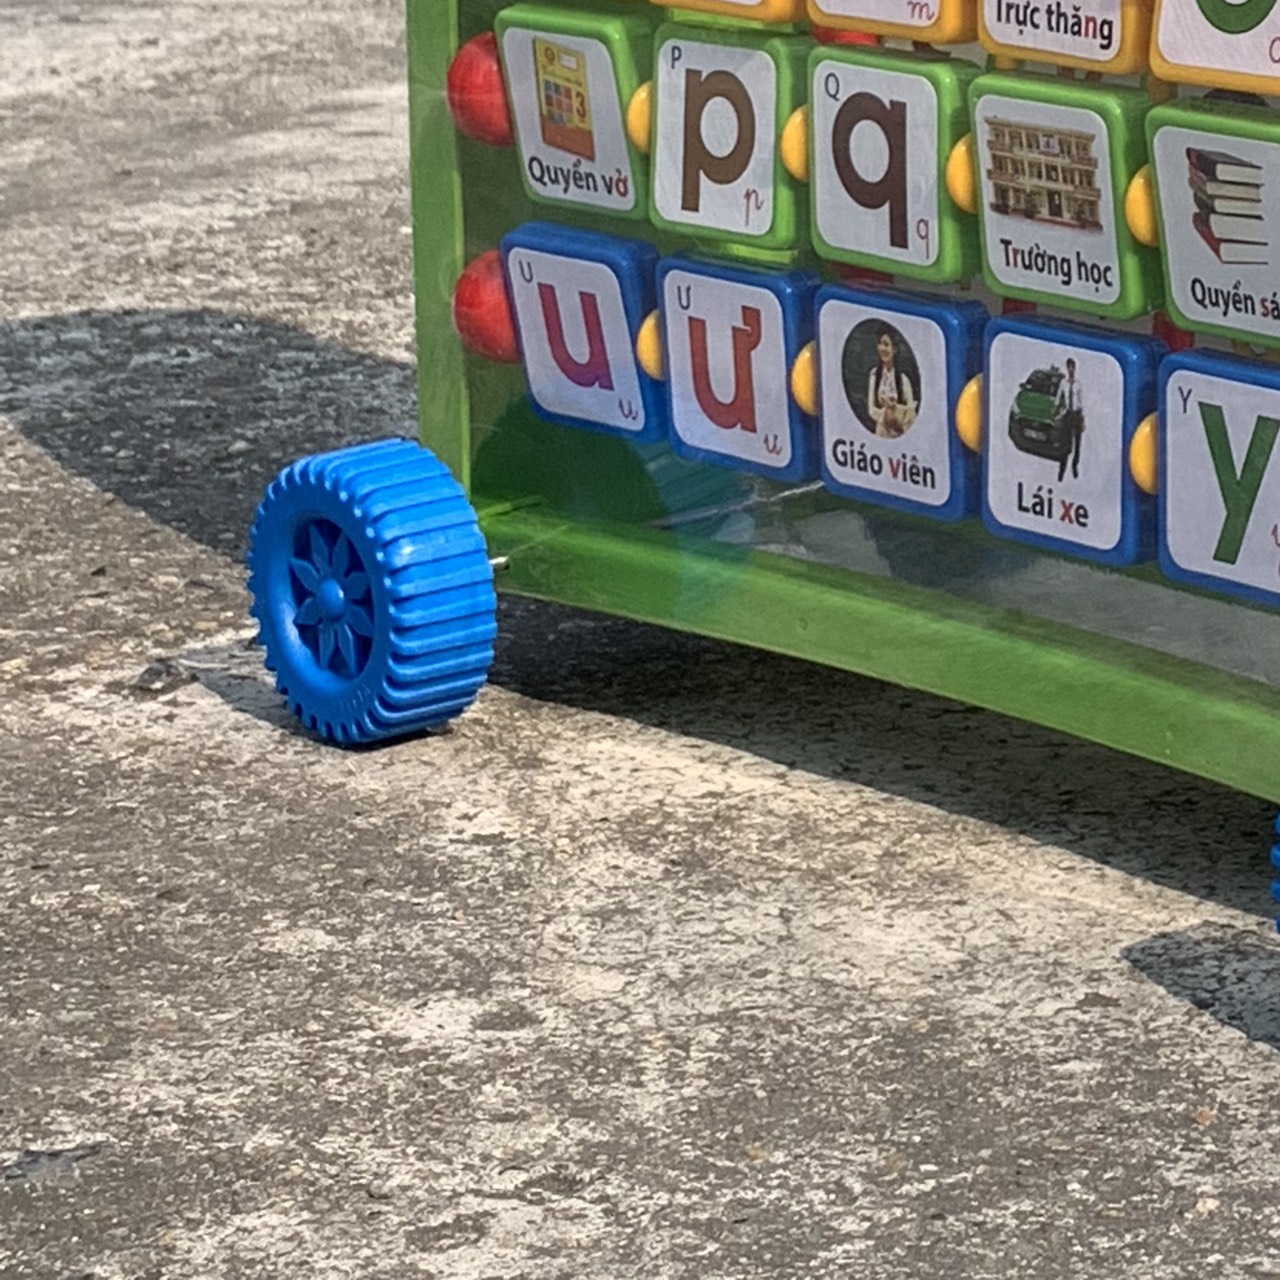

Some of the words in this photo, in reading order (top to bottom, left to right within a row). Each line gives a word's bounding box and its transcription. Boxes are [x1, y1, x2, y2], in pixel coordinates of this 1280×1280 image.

[1046, 1, 1114, 50] thăng
[671, 45, 682, 70] P
[824, 72, 841, 103] Q
[680, 67, 756, 213] p
[528, 156, 598, 195] Quyển
[601, 168, 629, 197] vở
[831, 91, 908, 249] q
[519, 260, 534, 284] U
[1000, 238, 1072, 286] Trường
[1076, 251, 1113, 293] học
[1191, 277, 1256, 317] Quyển
[537, 283, 615, 391] u
[688, 305, 761, 433] ư
[1178, 386, 1193, 414] Y
[832, 438, 882, 480] Giáo
[888, 455, 937, 490] viên
[1016, 481, 1053, 519] Lái
[1060, 499, 1090, 528] xe
